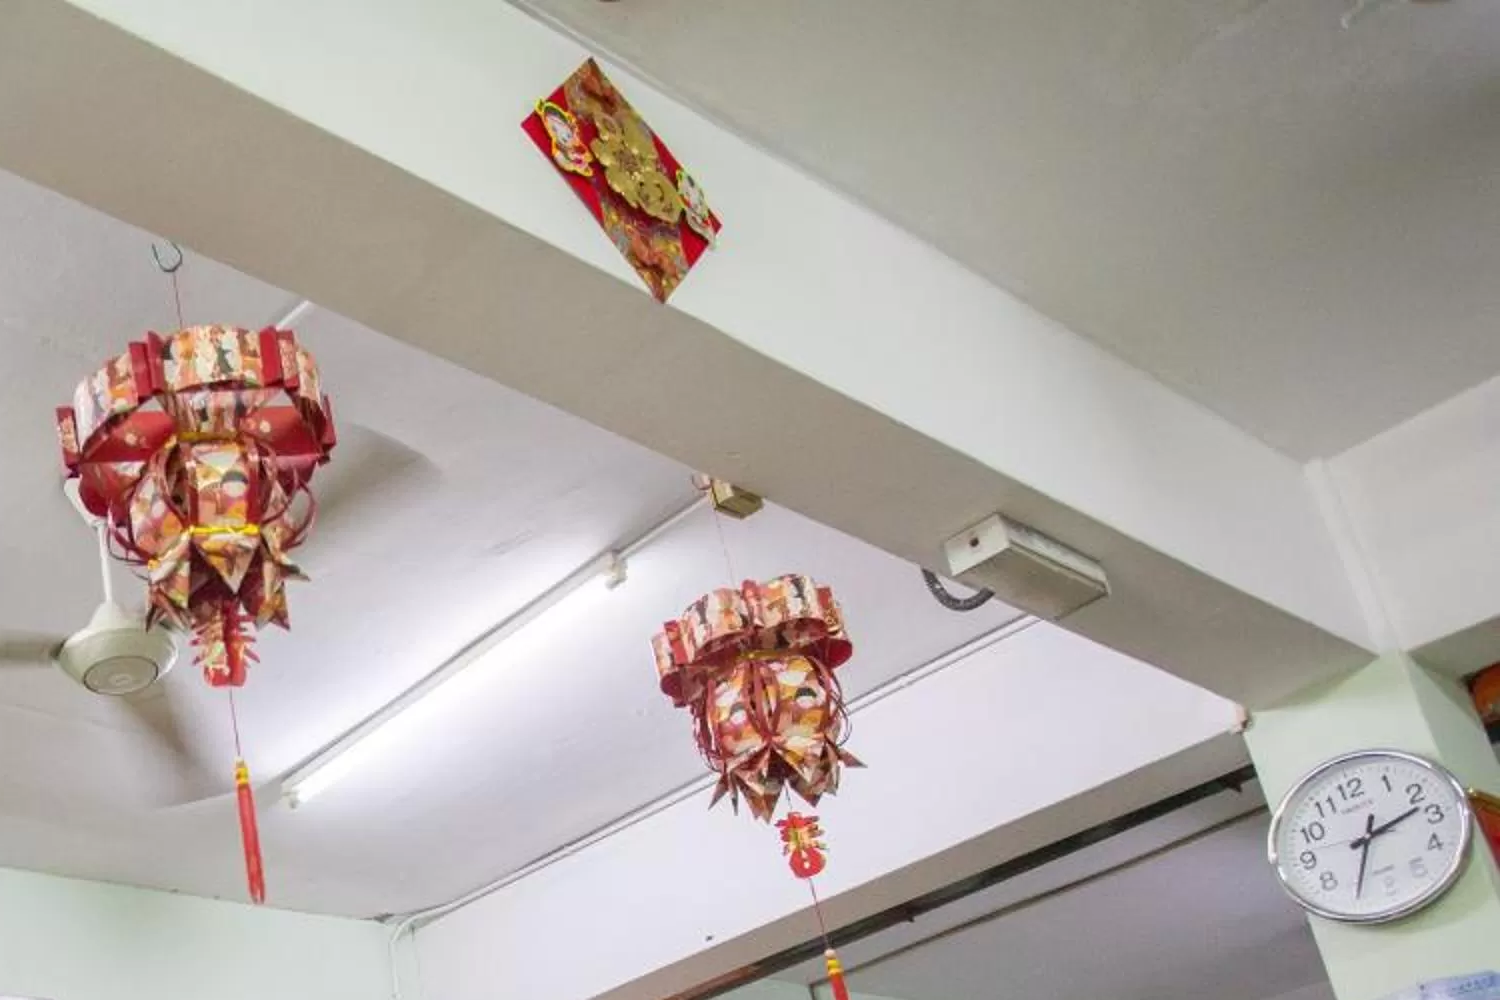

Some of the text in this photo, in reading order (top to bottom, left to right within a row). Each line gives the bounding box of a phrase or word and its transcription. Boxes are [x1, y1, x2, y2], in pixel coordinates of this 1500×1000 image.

[1338, 777, 1364, 800] 12
[1381, 774, 1392, 792] 1
[1405, 783, 1424, 804] 2
[1315, 795, 1337, 818] 11
[1425, 804, 1444, 824] 3
[1301, 821, 1325, 844] 10
[1427, 832, 1443, 851] 4
[1300, 851, 1317, 870] 9
[1319, 871, 1338, 891] 8
